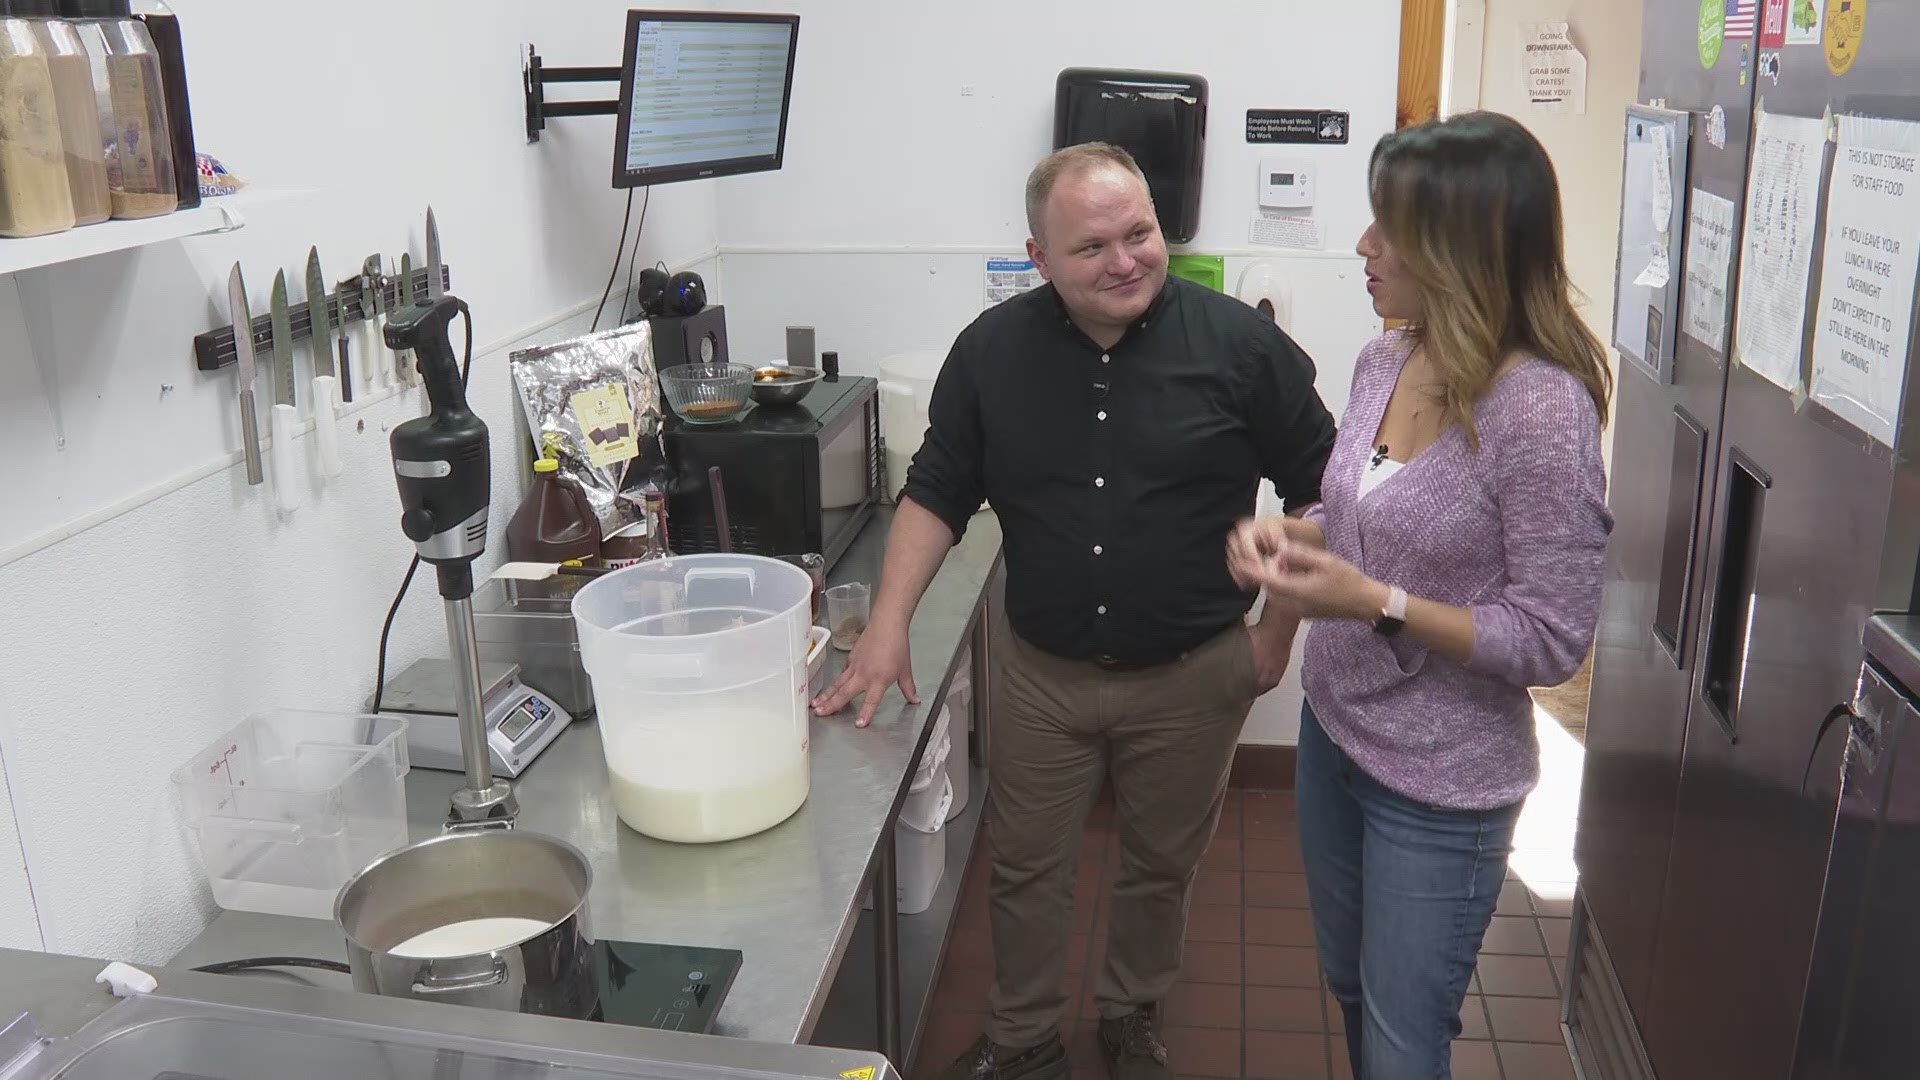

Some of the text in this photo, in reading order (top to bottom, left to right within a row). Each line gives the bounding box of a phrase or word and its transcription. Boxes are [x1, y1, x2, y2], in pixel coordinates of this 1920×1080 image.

[1529, 67, 1571, 75] GRAB SOME
[1536, 78, 1565, 86] CRATES!
[1528, 89, 1572, 97] THANK YOU!
[1287, 126, 1316, 134] Returning
[1848, 149, 1916, 173] THIS IS NOT STORAGE
[200, 186, 236, 196] ROWN
[1852, 174, 1904, 196] FOR STAFF FOOD
[1841, 226, 1900, 255] IF YOU LEAVE YOUR
[1844, 252, 1891, 278] LUNCH IN HERE
[1846, 276, 1882, 300] OVERNIGHT
[1832, 297, 1892, 333] DON'T EXPECT IT TO
[1828, 319, 1890, 358] STILL BE HERE IN THE
[1840, 348, 1870, 375] MORNING
